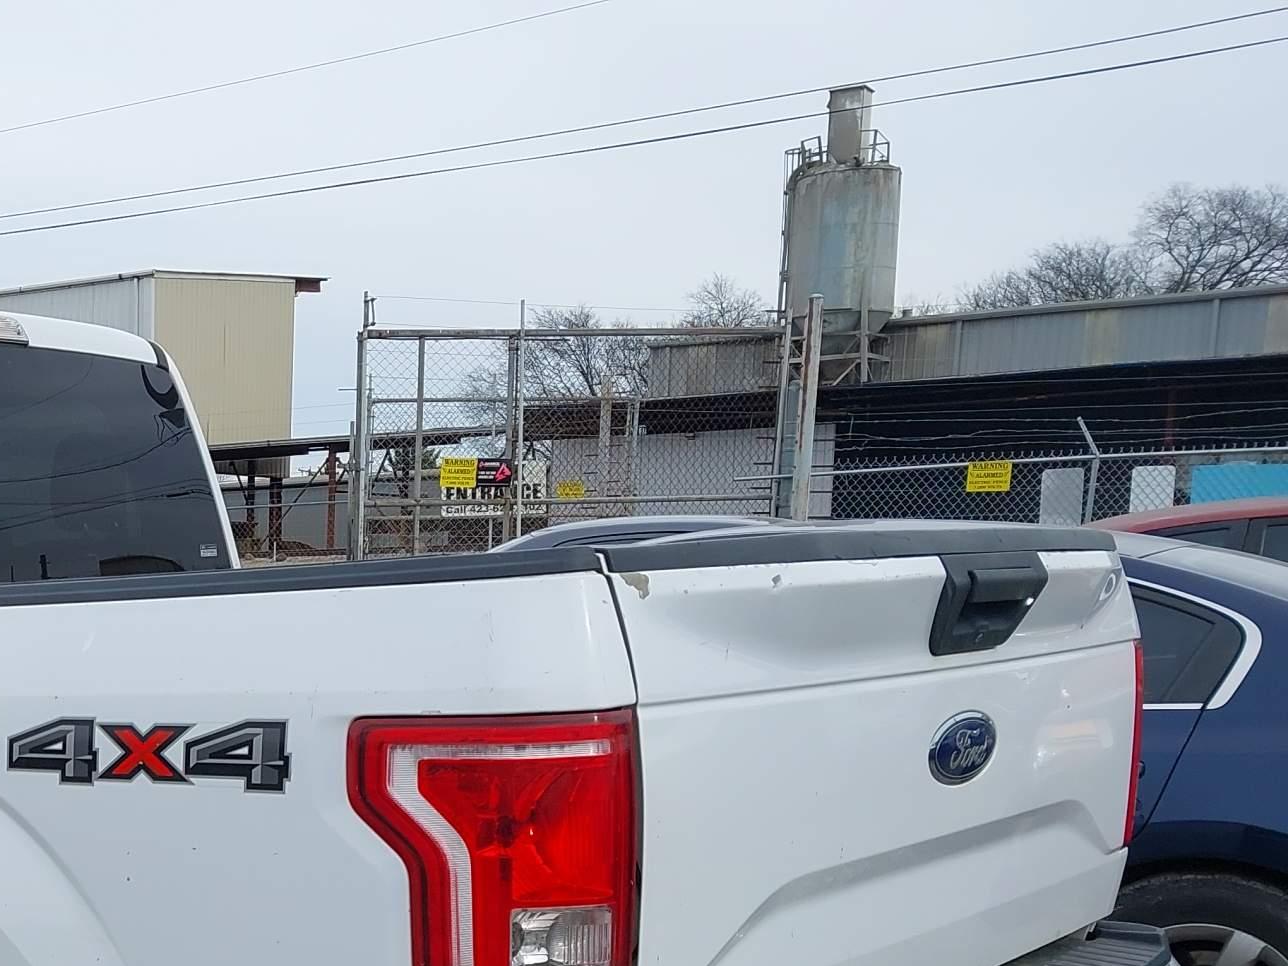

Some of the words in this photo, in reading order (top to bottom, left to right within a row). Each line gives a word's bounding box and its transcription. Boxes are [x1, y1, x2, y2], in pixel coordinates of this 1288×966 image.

[444, 458, 475, 466] WARNING
[972, 462, 1009, 470] WARNING
[446, 504, 466, 514] Call
[950, 728, 989, 769] Ford
